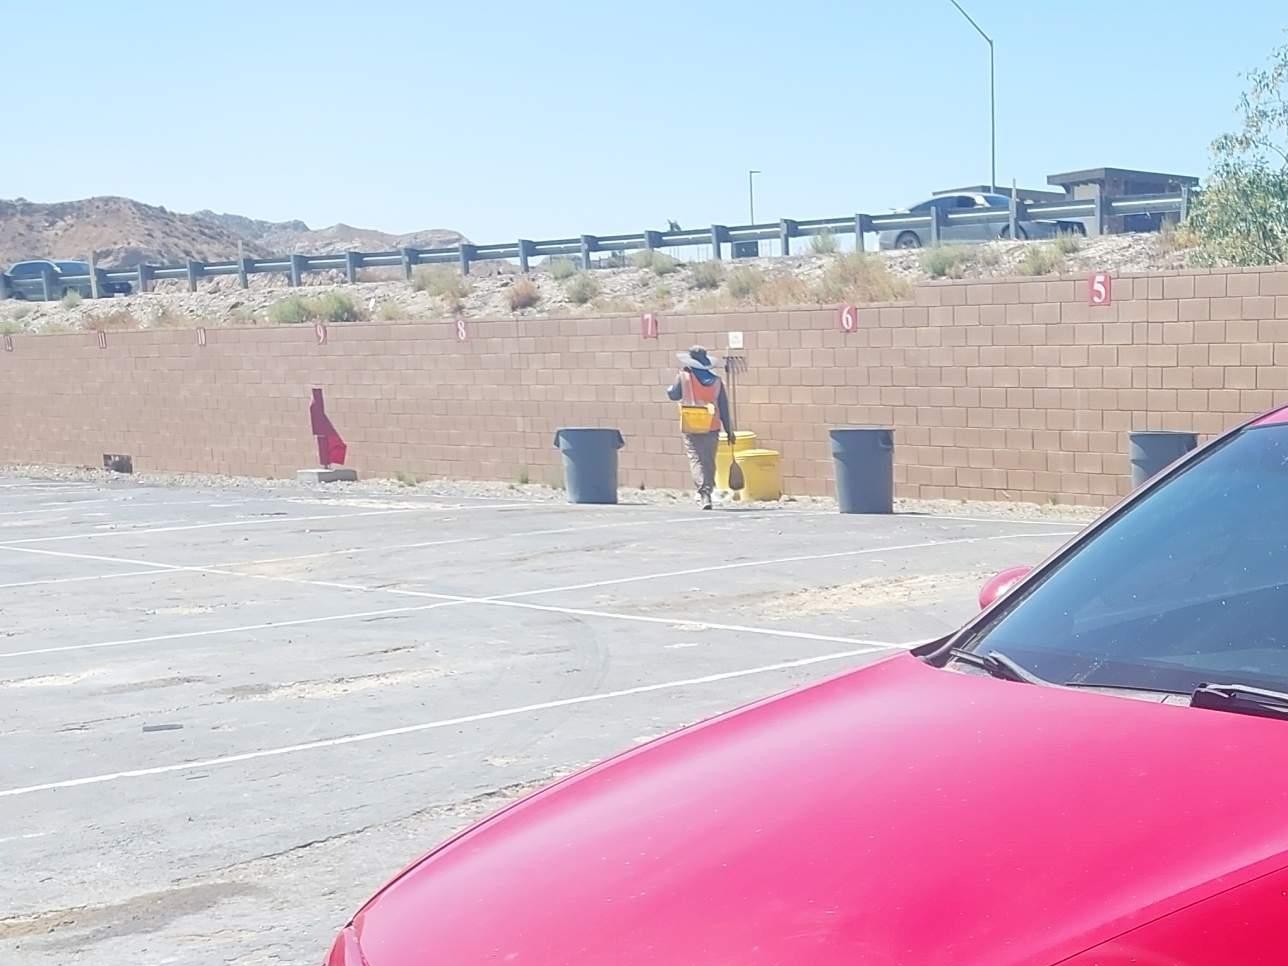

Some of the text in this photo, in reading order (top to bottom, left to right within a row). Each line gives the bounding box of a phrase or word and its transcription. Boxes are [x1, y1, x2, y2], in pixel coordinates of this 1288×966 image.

[1092, 274, 1107, 304] 5
[456, 319, 467, 341] 8
[643, 313, 653, 336] 7
[841, 305, 853, 331] 6
